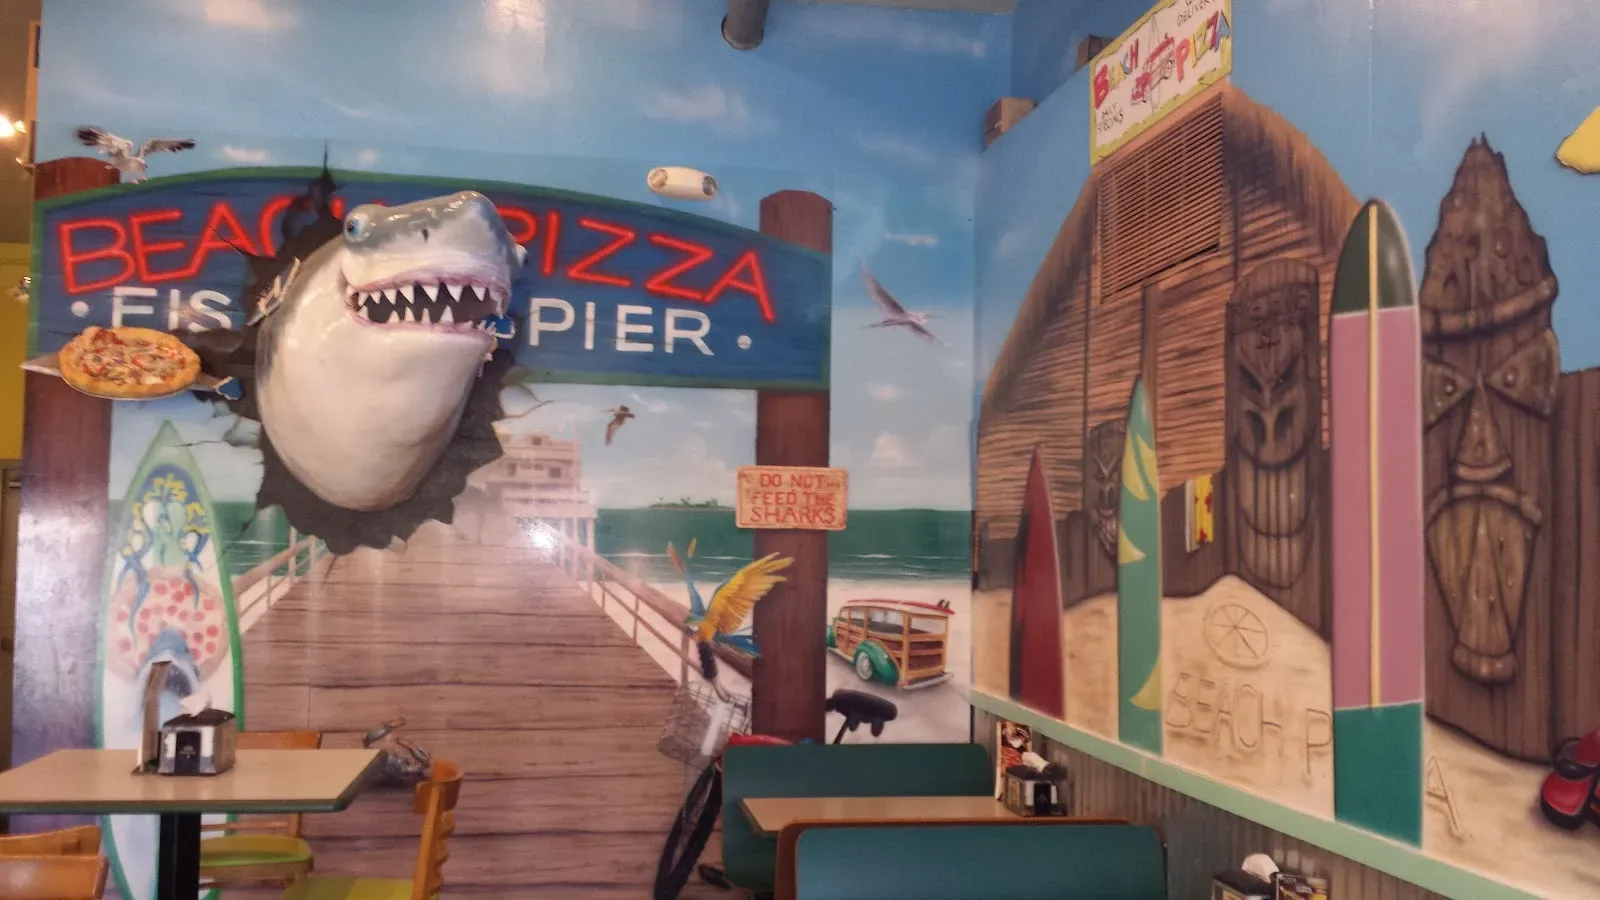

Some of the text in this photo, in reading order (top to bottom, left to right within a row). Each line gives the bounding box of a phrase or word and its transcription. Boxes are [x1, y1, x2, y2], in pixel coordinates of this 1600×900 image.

[496, 204, 776, 324] PIZZA
[111, 286, 715, 356] FIS PIER
[759, 473, 825, 489] DO NOT
[750, 491, 834, 507] FEED THE
[750, 506, 836, 525] SHARKS
